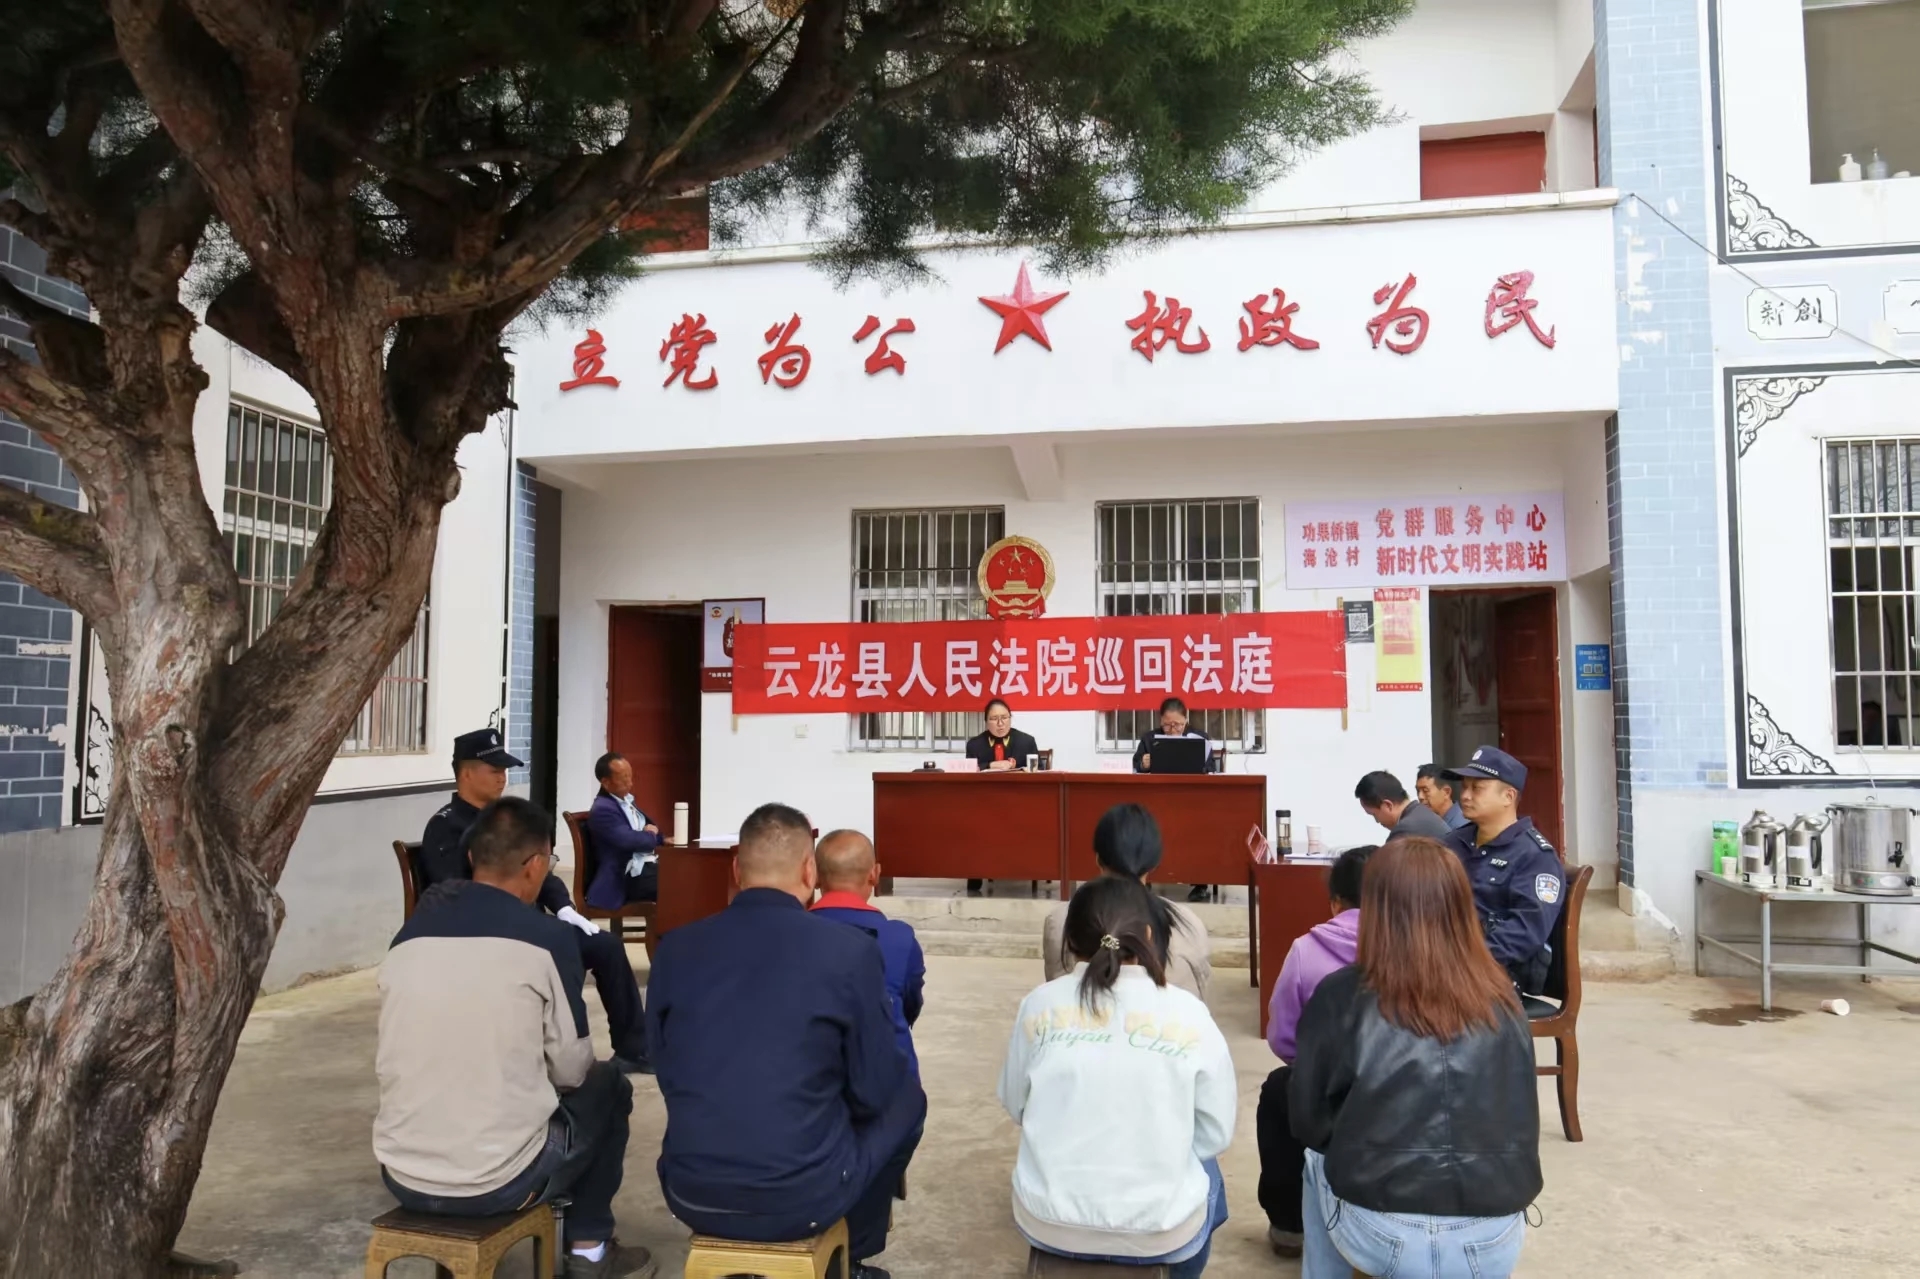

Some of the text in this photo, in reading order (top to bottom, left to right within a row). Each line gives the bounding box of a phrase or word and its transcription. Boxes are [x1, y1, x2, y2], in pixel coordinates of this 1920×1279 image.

[1125, 269, 1556, 362] 执政为民
[559, 312, 916, 392] 立党为公
[1302, 520, 1359, 542] 功果桥镇
[1375, 503, 1547, 539] 党群服务中心
[1376, 539, 1548, 576] 新时代文明实践站
[764, 631, 1276, 700] 云龙县人民法院巡回法庭
